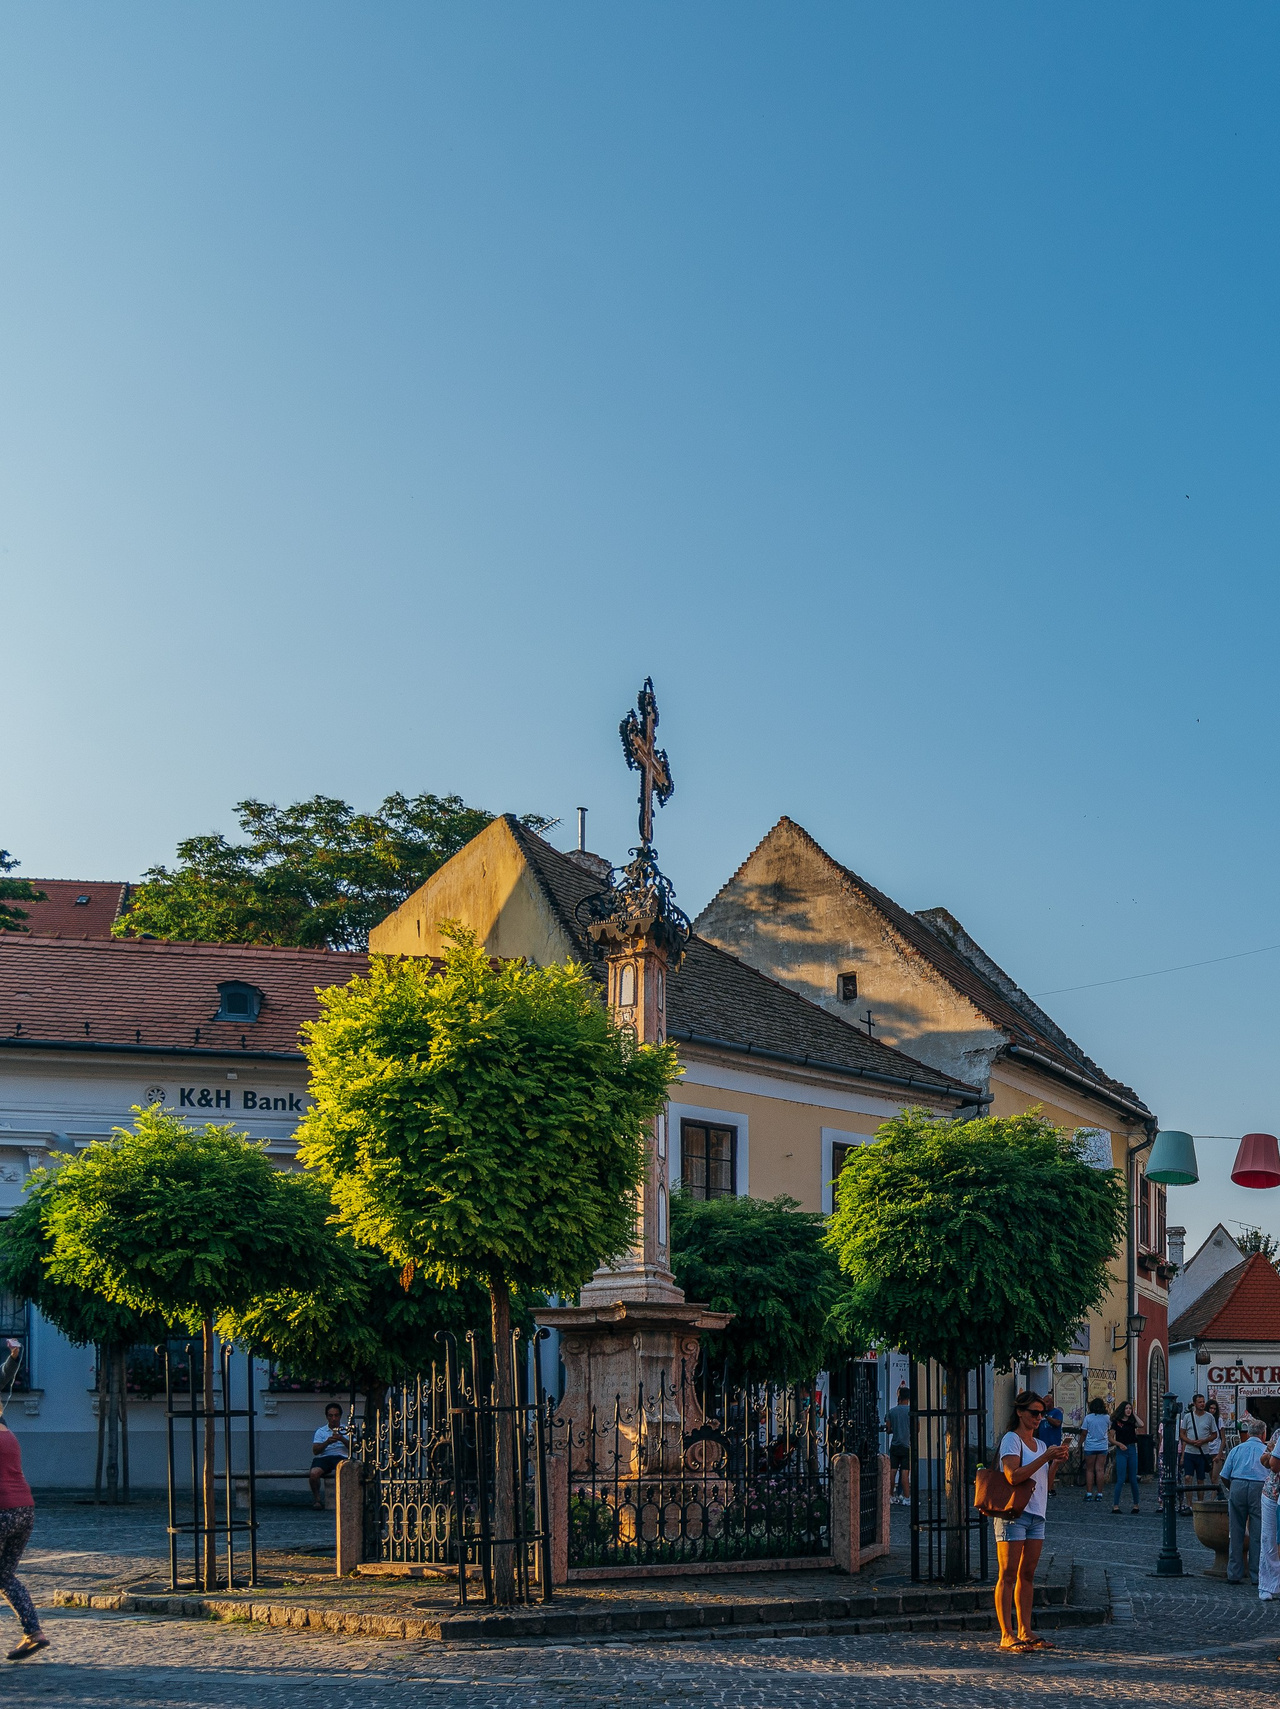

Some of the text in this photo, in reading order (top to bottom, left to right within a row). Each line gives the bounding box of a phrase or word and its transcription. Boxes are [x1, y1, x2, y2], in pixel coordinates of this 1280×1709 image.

[180, 1088, 303, 1111] K&H Bank
[1267, 1386, 1276, 1395] Ice
